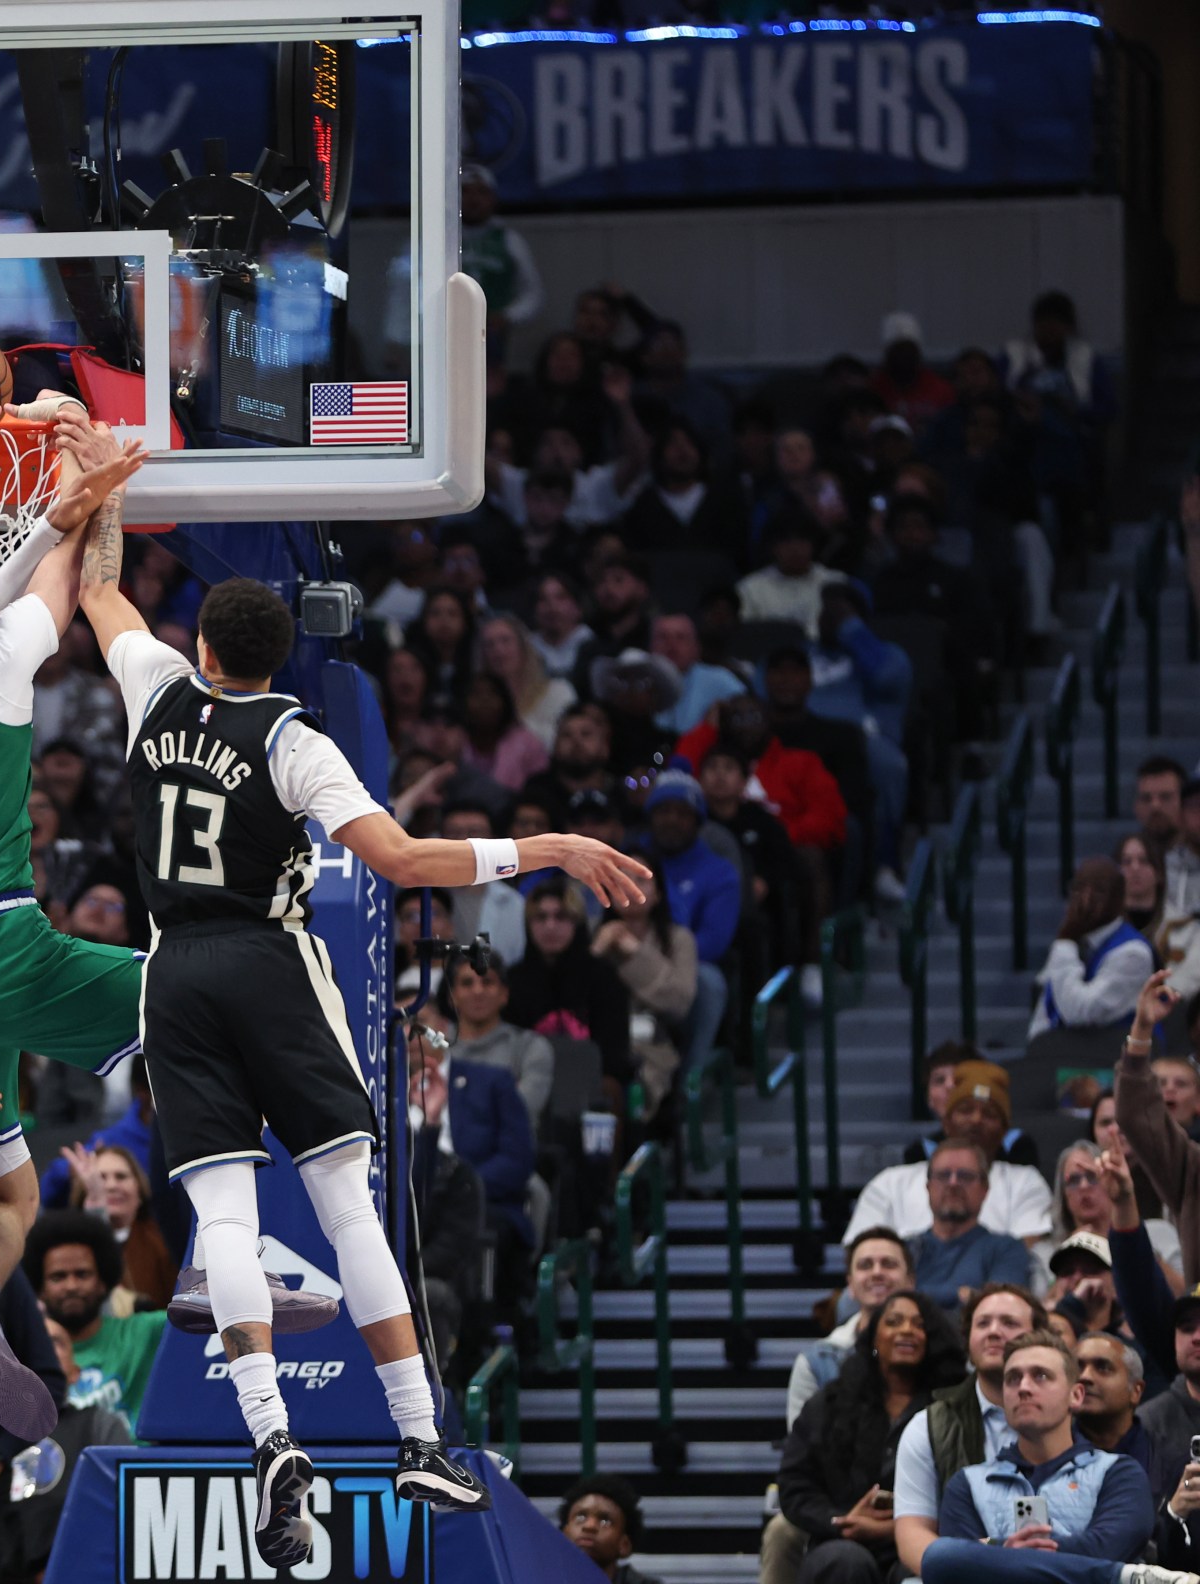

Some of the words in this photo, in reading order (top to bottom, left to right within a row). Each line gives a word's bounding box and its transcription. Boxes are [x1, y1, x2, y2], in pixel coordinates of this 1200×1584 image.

[534, 40, 969, 188] BREAKERS
[142, 730, 252, 791] ROLLINS
[157, 783, 226, 887] 13
[205, 1361, 345, 1380] DAGO
[305, 1378, 330, 1389] EV
[334, 1476, 413, 1579] TV
